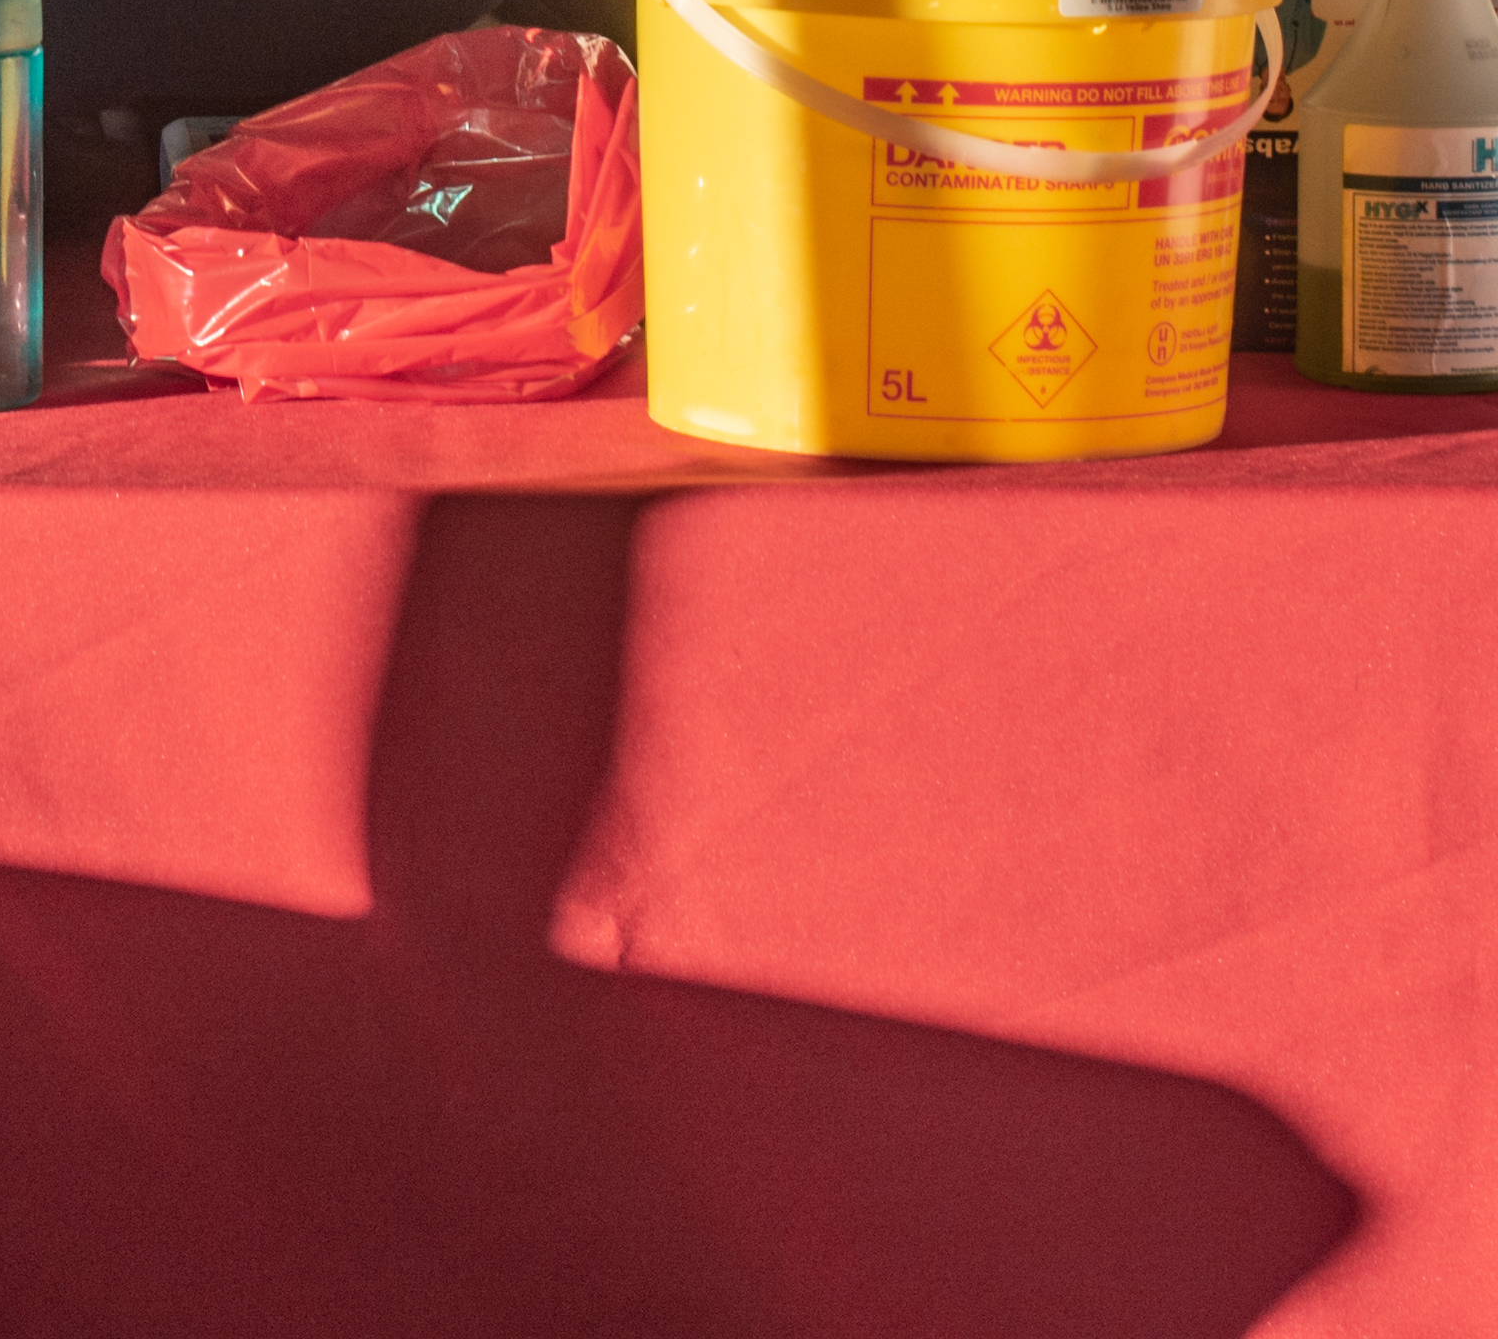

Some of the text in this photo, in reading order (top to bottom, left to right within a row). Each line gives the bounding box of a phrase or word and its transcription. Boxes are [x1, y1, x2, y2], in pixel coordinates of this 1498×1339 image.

[994, 87, 1072, 103] WARNING
[1076, 87, 1099, 103] DO
[1103, 86, 1134, 103] NOT
[1136, 85, 1163, 101] FILL
[885, 171, 1040, 191] CONTAMINATED
[1421, 181, 1450, 190] HAND
[1155, 233, 1198, 251] HANDLE
[1154, 253, 1170, 267] UN
[1016, 354, 1071, 364] INFECTIOUS
[881, 369, 928, 403] 5L
